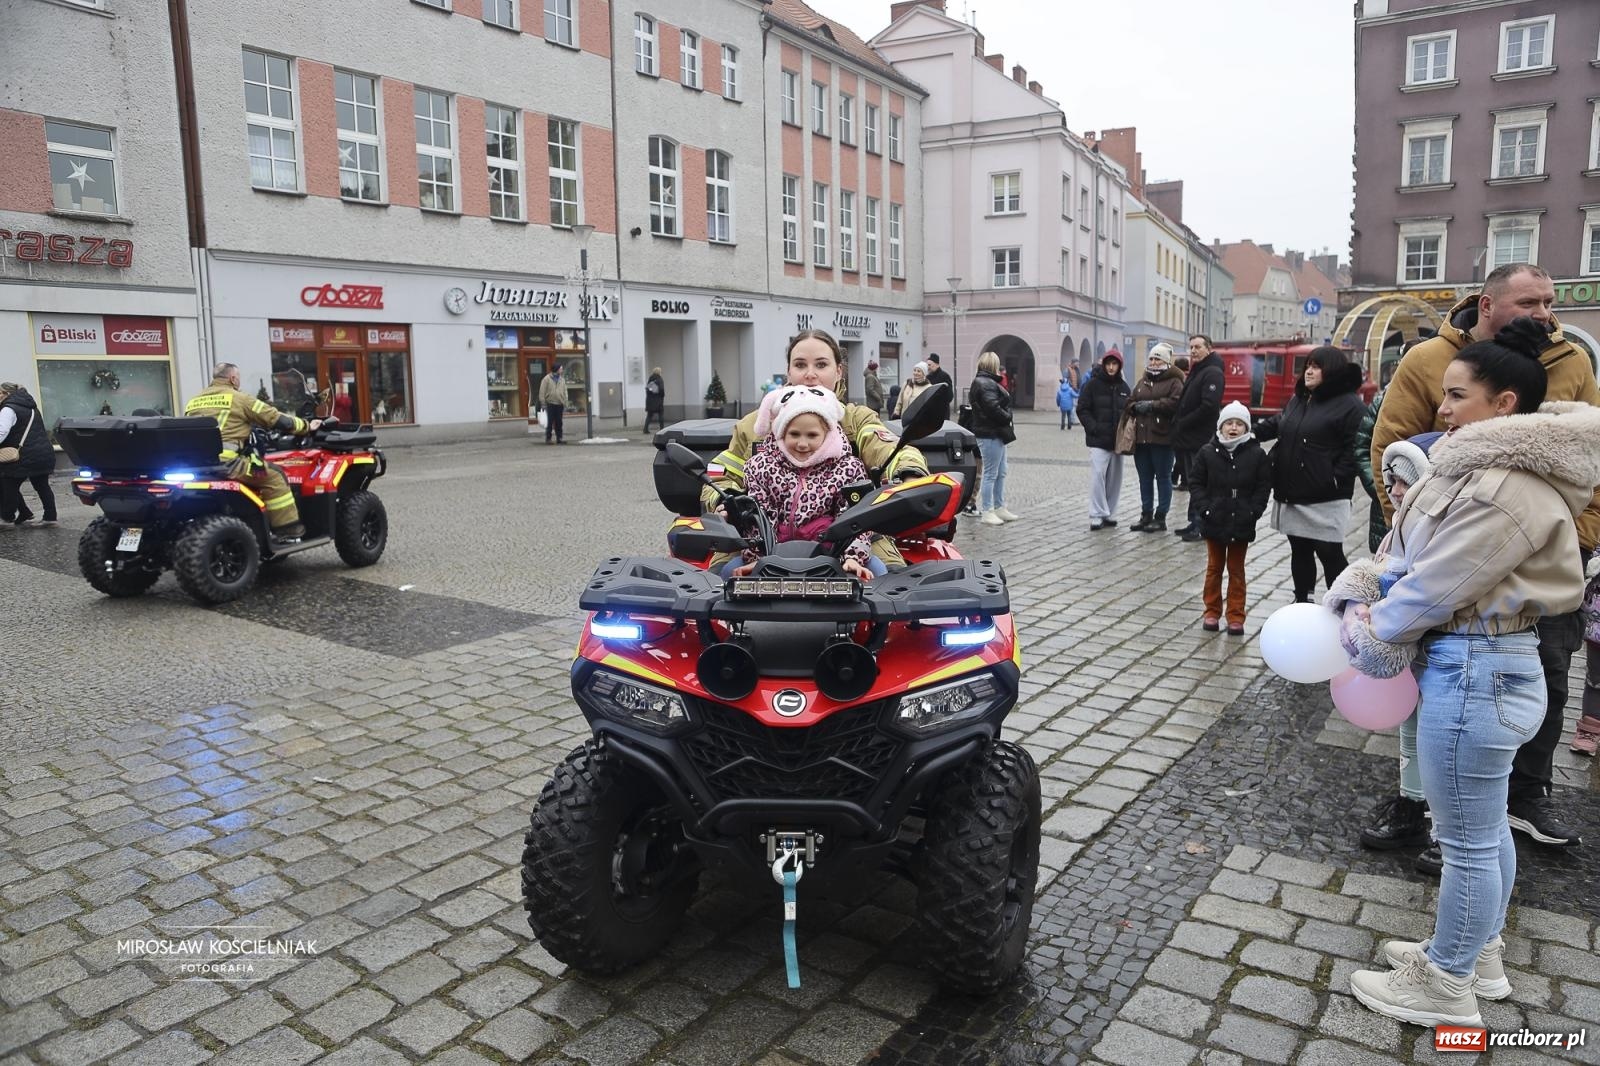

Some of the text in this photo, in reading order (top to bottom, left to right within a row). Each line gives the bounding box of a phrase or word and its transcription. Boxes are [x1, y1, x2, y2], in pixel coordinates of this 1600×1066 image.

[475, 281, 569, 308] JUBILER
[1553, 283, 1600, 303] TO
[651, 299, 690, 314] BOLKO
[714, 308, 750, 318] RACIBORSKA
[490, 310, 558, 323] ZEGARMISTRZ
[833, 311, 872, 328] JUBILER
[57, 328, 97, 341] Bliski
